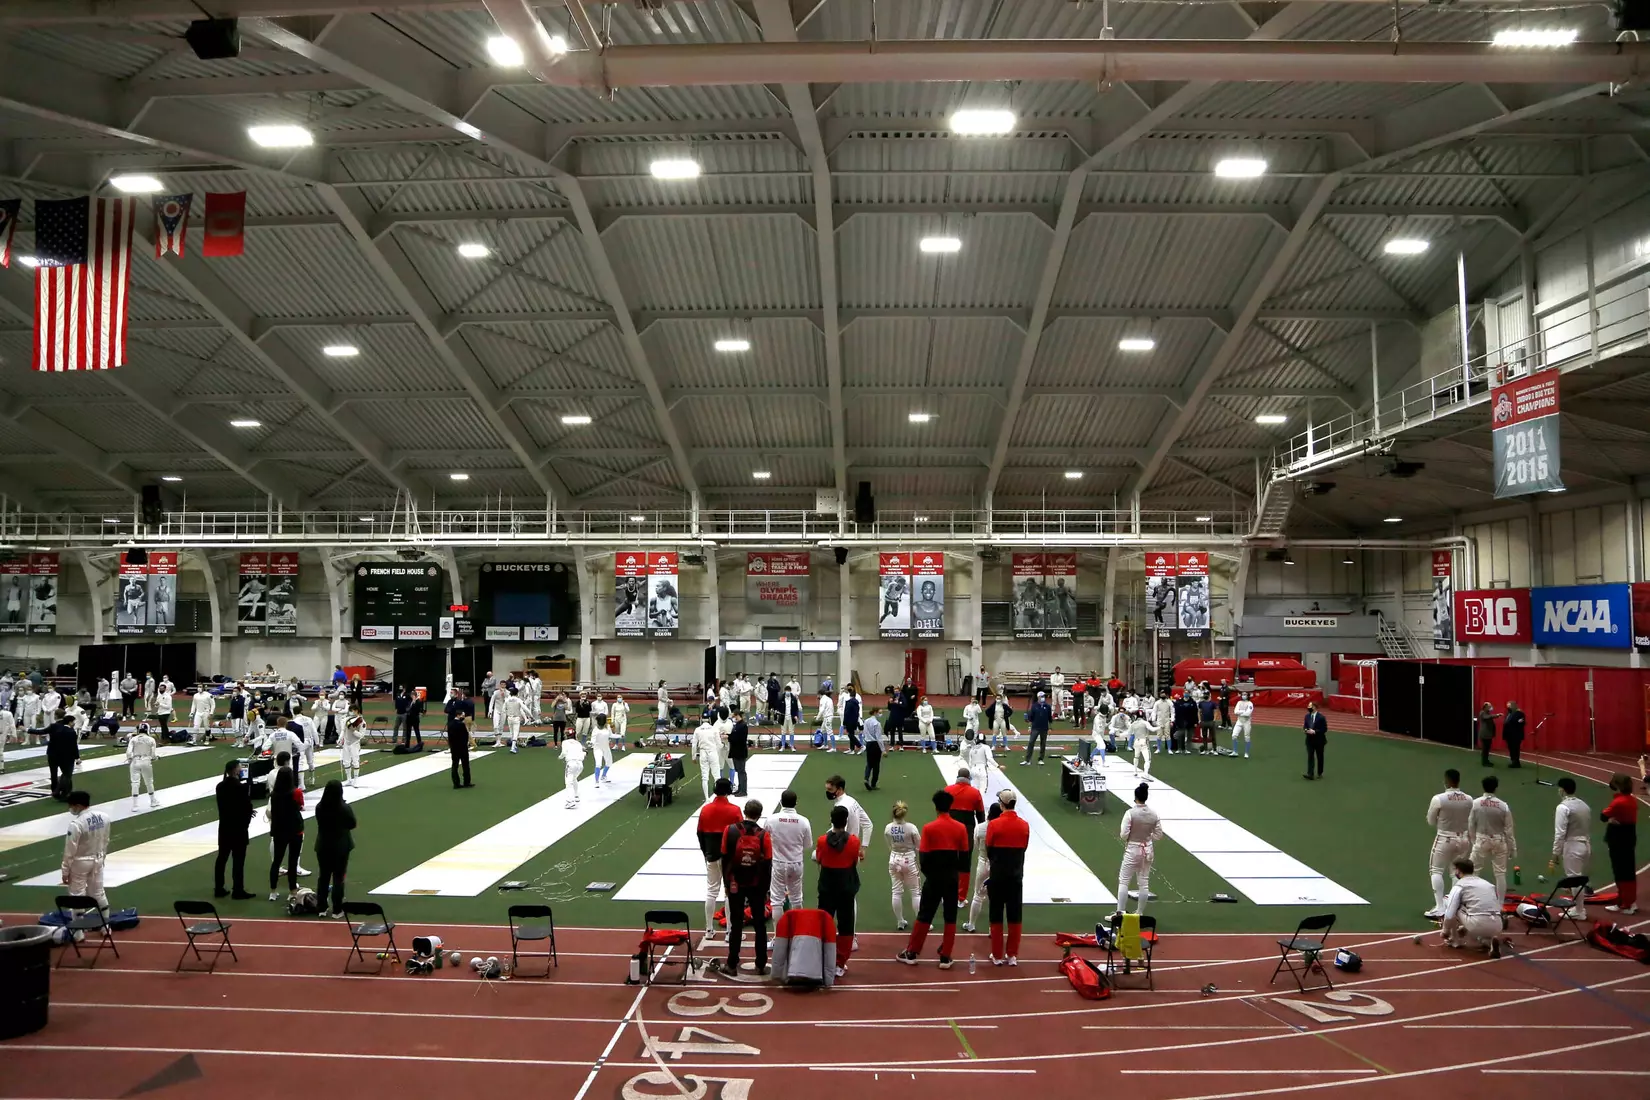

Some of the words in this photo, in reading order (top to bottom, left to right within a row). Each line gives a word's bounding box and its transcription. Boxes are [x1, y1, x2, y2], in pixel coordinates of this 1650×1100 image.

[1517, 396, 1556, 415] CHAMPIONS
[1506, 425, 1547, 459] 2011
[1506, 454, 1549, 486] 2015
[495, 564, 551, 572] BUCKEYES
[760, 593, 798, 601] DREAMS
[1543, 599, 1612, 634] NCAA
[890, 826, 905, 835] SEAL
[892, 834, 905, 843] USA
[667, 990, 774, 1017] 3
[1270, 990, 1395, 1023] 2
[641, 1026, 761, 1060] 4
